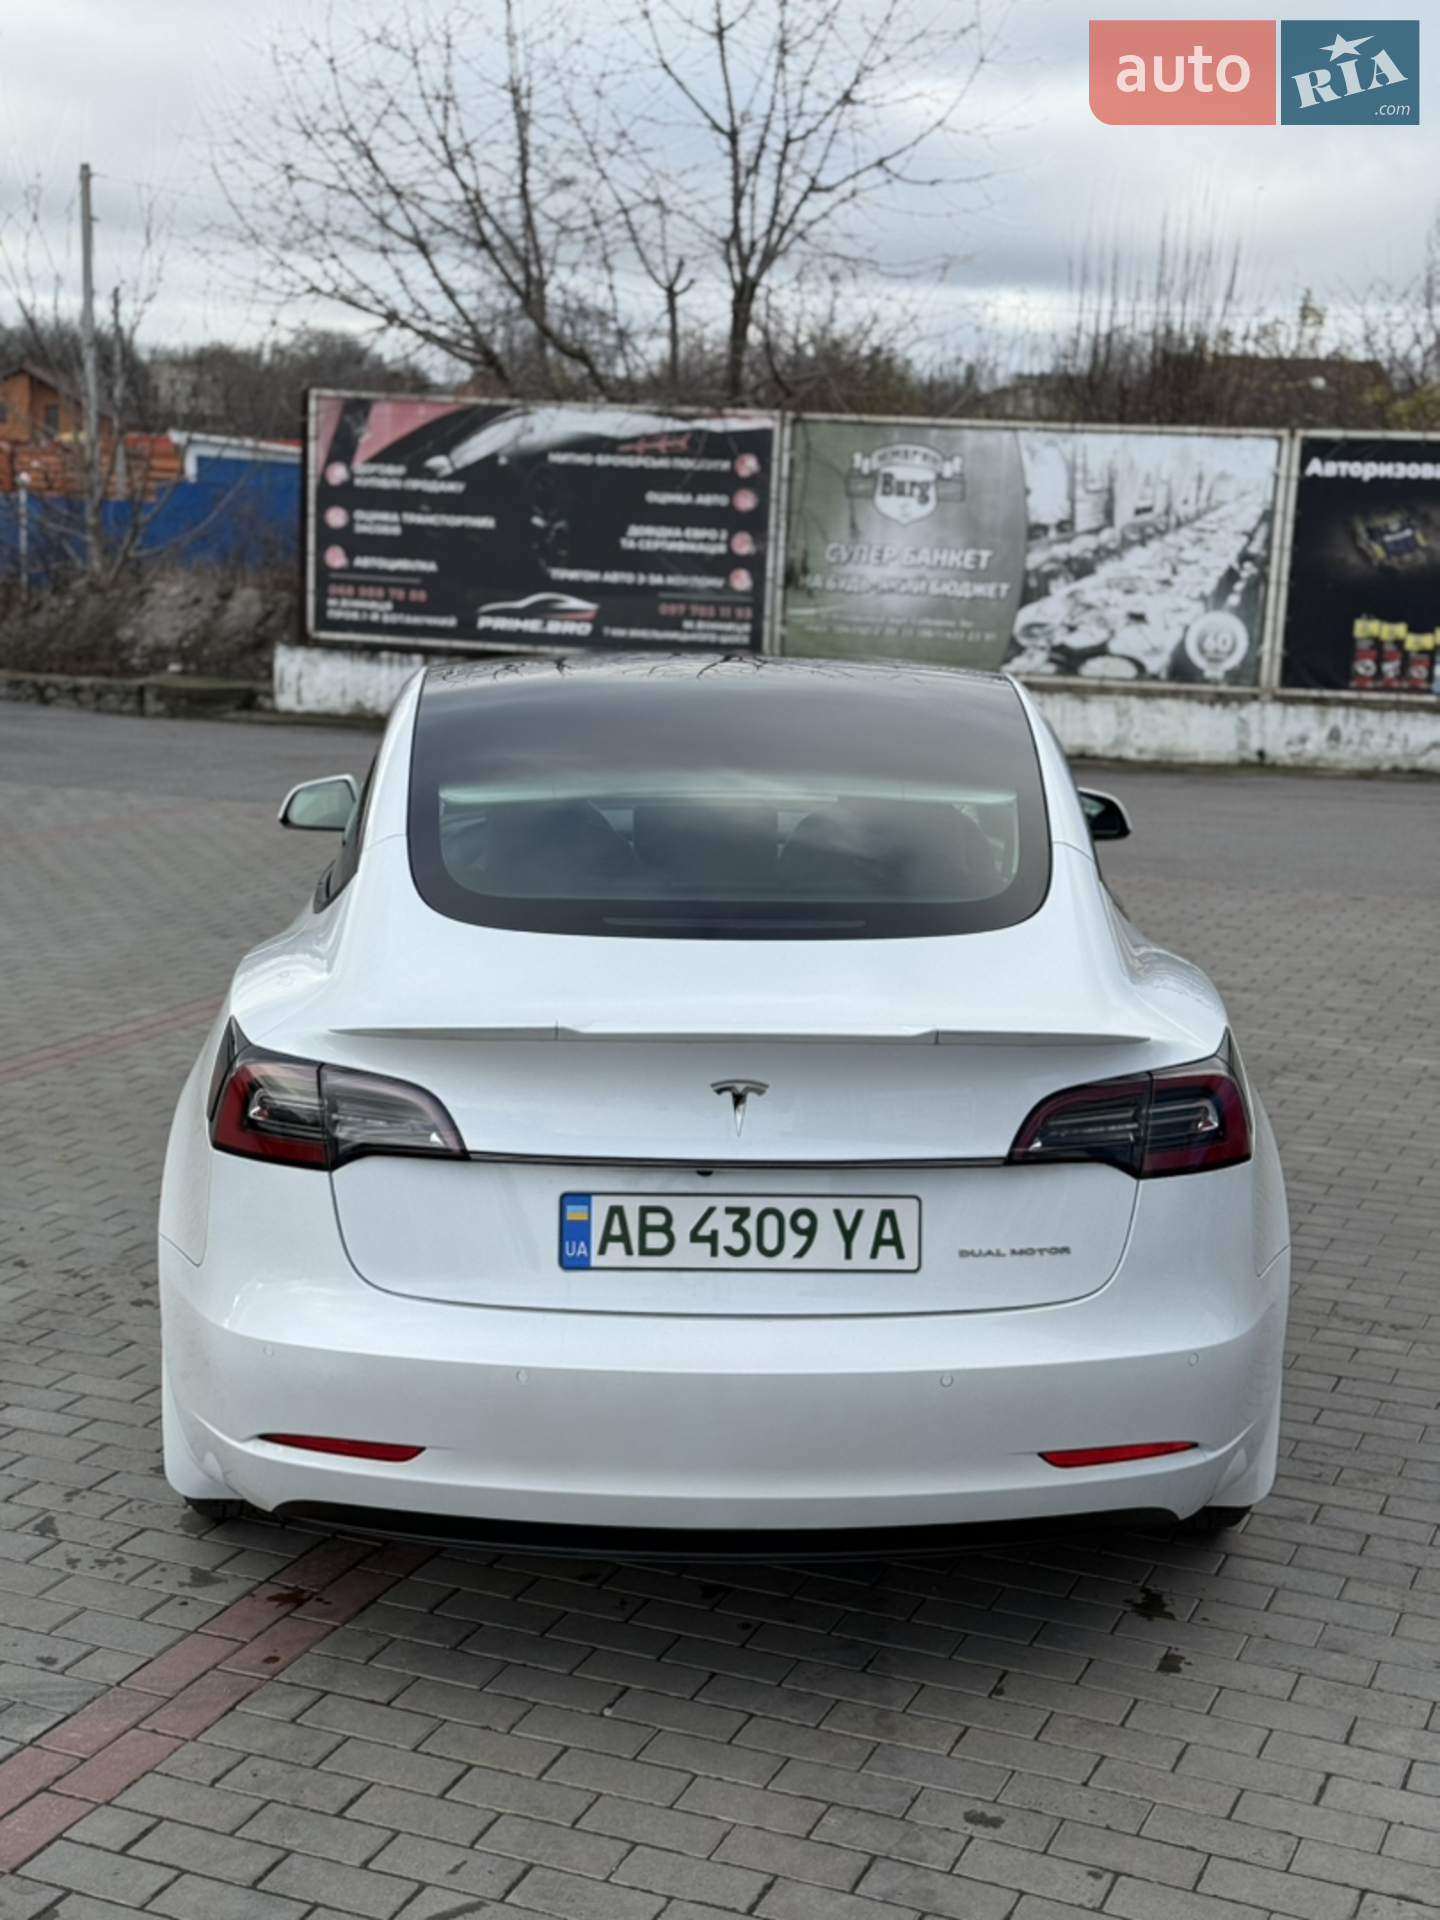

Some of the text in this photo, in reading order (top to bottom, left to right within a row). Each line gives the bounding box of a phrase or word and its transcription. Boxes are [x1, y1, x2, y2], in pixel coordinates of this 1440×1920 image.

[881, 473, 931, 505] Burg
[825, 544, 994, 571] СУПЕР БАНКЕТ
[597, 1205, 905, 1260] AB 4309 YA
[565, 1241, 589, 1257] UA
[959, 1245, 1071, 1258] DUAL MOTOR
